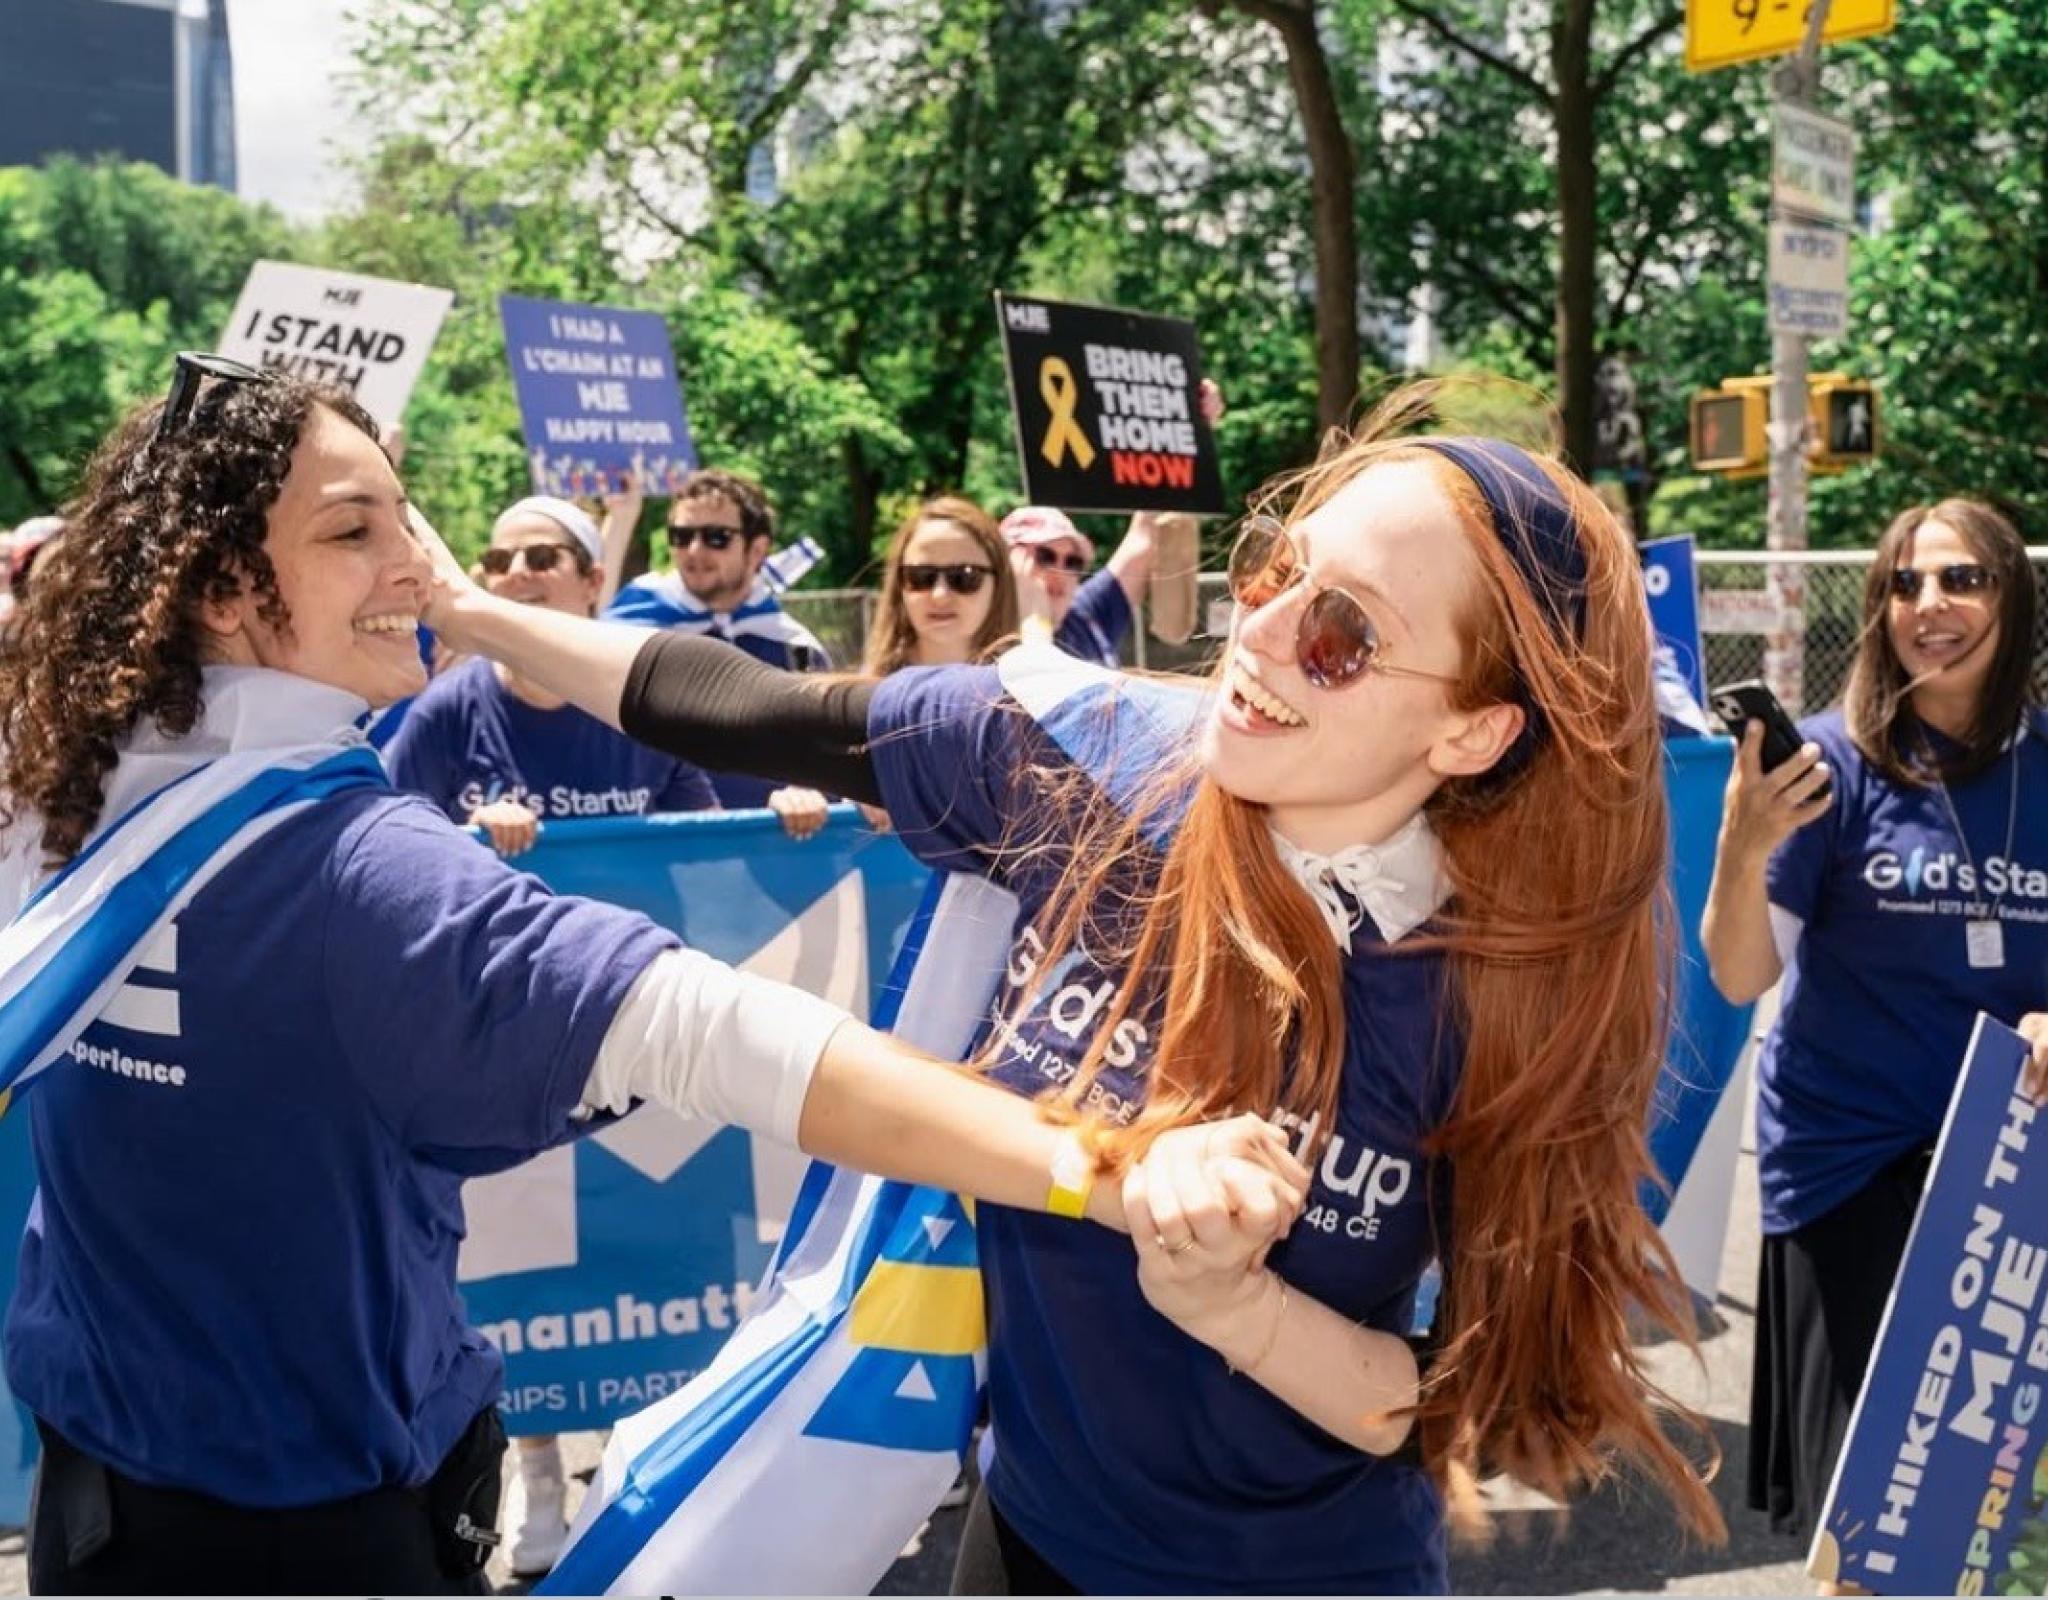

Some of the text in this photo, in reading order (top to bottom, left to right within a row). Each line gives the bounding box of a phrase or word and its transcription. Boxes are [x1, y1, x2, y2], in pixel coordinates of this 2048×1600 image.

[324, 288, 363, 306] MJE
[245, 308, 405, 364] I STAND
[550, 314, 625, 345] I HAD A
[1006, 303, 1050, 333] MJE
[261, 350, 366, 391] WITH
[610, 353, 634, 378] AT
[1083, 343, 1188, 388] BRING
[577, 380, 631, 412] MJE
[1093, 380, 1190, 421] THEM
[545, 418, 674, 445] HAPPY HOUR
[1098, 414, 1198, 456] HOME
[1110, 450, 1194, 489] NOW
[551, 785, 650, 817] Startup
[1983, 855, 2048, 898] Sta
[1038, 1050, 1075, 1084] 127
[1304, 1204, 1340, 1233] 48
[1345, 1214, 1381, 1241] CE
[1951, 1203, 2004, 1311] ON
[1948, 1235, 2048, 1445] MJE
[599, 1368, 697, 1406] PART
[1875, 1324, 1963, 1537] HIKED
[1955, 1382, 2042, 1597] SPRING
[1864, 1551, 1898, 1575] I
